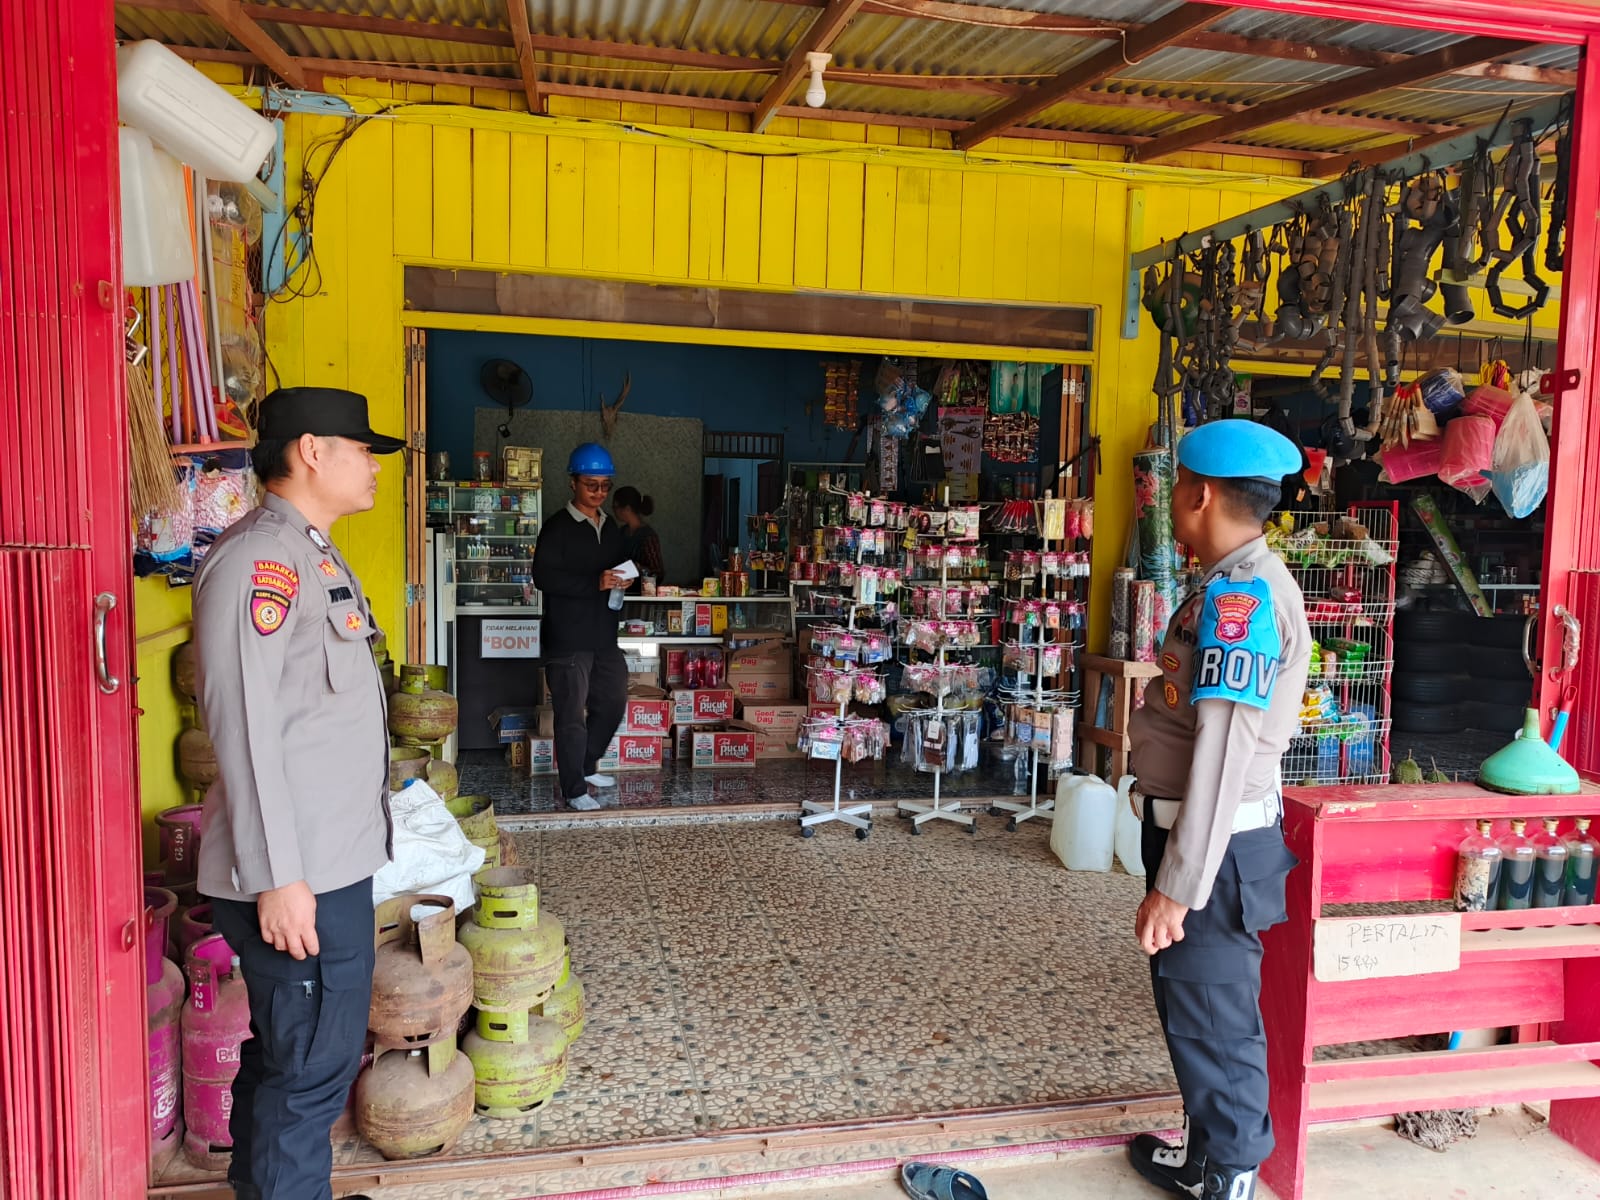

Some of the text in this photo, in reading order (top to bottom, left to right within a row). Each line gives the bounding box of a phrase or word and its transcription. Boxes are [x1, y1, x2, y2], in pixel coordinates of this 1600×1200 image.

[1198, 646, 1278, 699] ROV
[699, 700, 728, 713] pucuk
[634, 711, 663, 725] pucuk
[756, 716, 773, 724] Day
[625, 744, 656, 758] pucuk
[720, 743, 749, 756] pucuk
